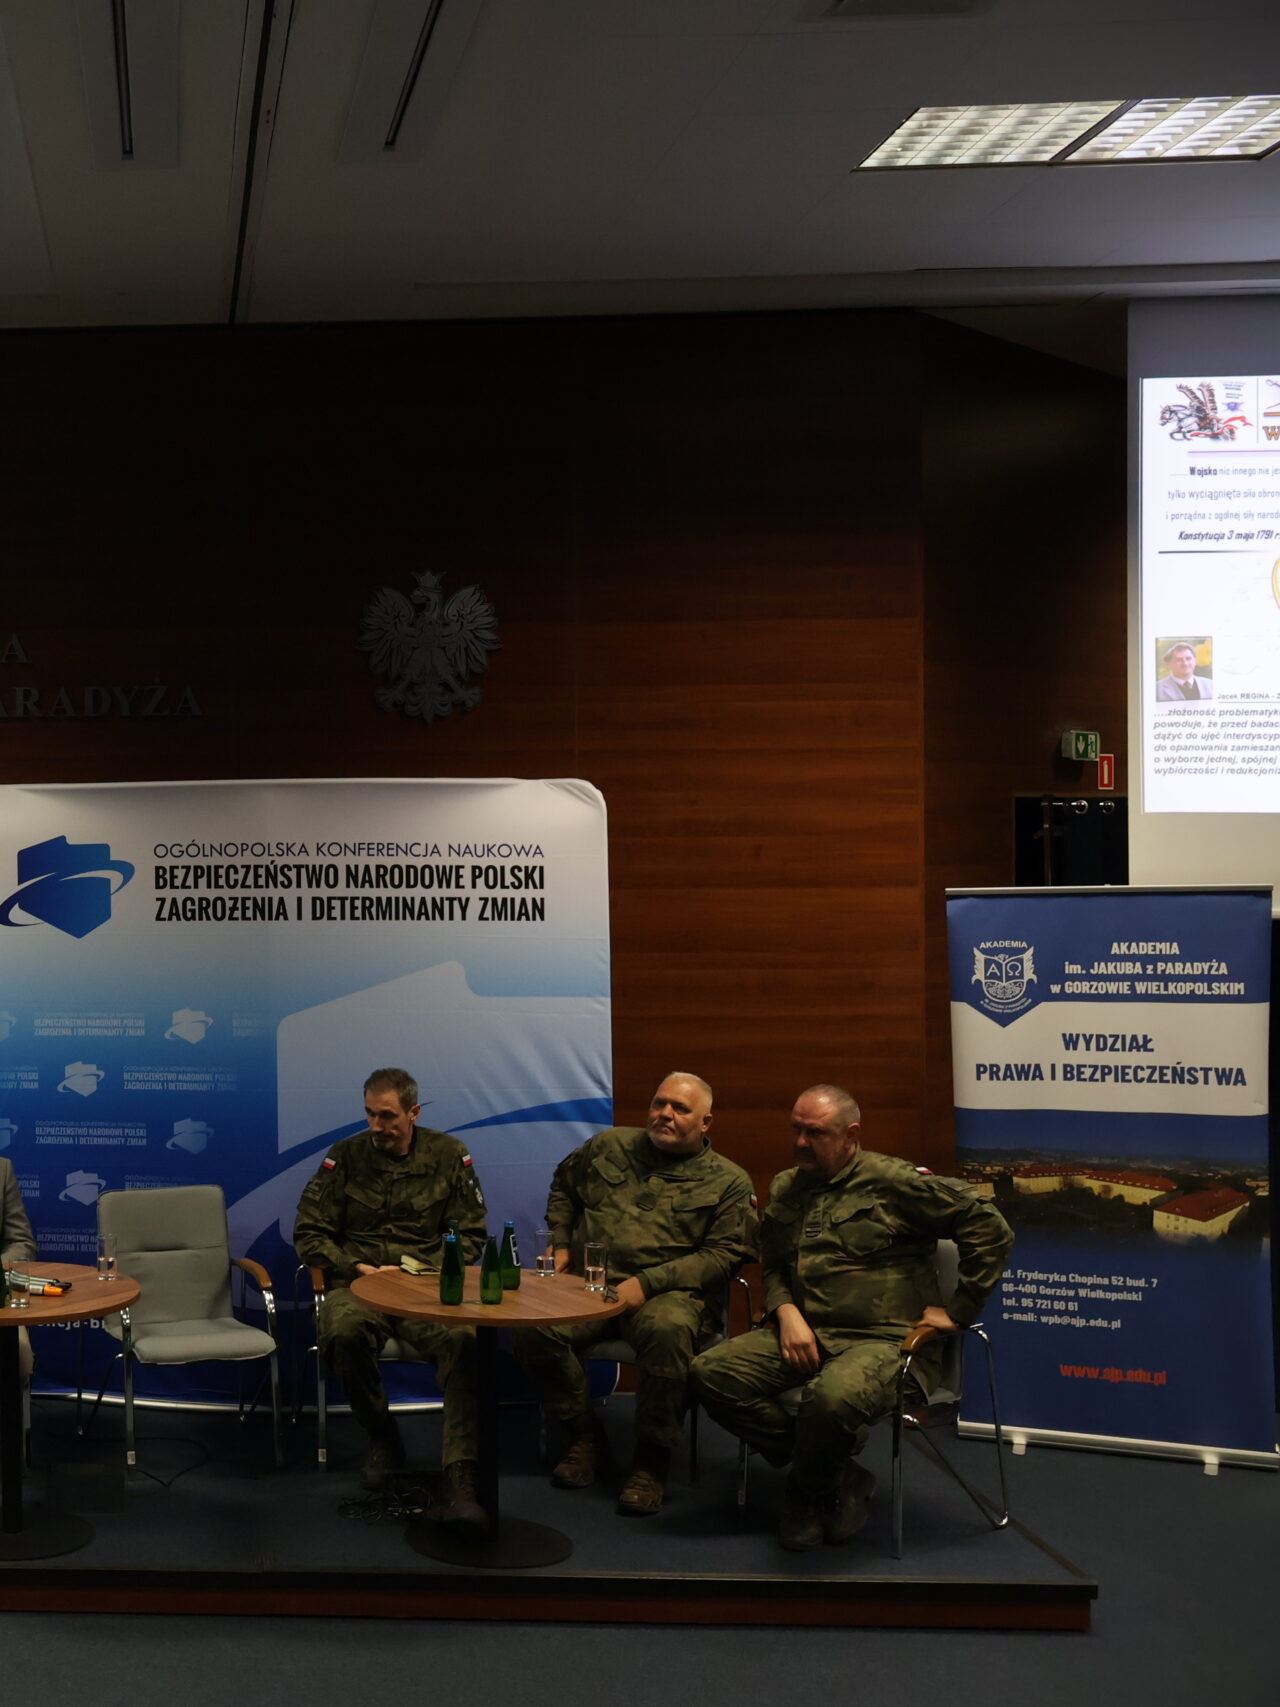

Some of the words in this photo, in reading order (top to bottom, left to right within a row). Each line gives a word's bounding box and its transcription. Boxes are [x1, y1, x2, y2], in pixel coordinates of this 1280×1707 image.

[1189, 466, 1218, 477] Wojsko
[1220, 719, 1248, 729] przed
[1185, 731, 1198, 740] do
[1153, 743, 1167, 752] do
[1169, 743, 1228, 753] opanowania
[1153, 756, 1161, 764] o
[1164, 754, 1204, 765] wyborze
[153, 839, 310, 859] OGÓLNOPOLSKA
[316, 841, 442, 859] KONFERENCJA
[448, 842, 545, 859] NAUKOWA
[154, 860, 339, 891] BEZPIECZEŃSTWO
[345, 863, 465, 891] NARODOWE
[471, 863, 545, 891] POLSKI
[154, 895, 289, 923] ZAGROŻENIA
[296, 895, 303, 922] I
[310, 896, 470, 923] DETERMINANTY
[477, 896, 546, 923] ZMIAN
[979, 940, 1028, 949] AKADEMIA
[1110, 941, 1180, 956] AKADEMIA
[1064, 961, 1086, 975] im.
[1090, 961, 1144, 975] JAKUBA
[1146, 964, 1154, 975] z
[1157, 958, 1229, 976] PARADYŻA
[1050, 983, 1062, 994] w
[1064, 981, 1132, 995] GORZOWIE
[1135, 981, 1246, 996] WIELKOPOLSKIM
[1062, 1032, 1154, 1053] WYDZIAŁ
[976, 1063, 1044, 1082] PRAWA
[1050, 1063, 1056, 1082] I
[1063, 1061, 1247, 1086] BEZPIECZEŃSTWA
[1016, 1269, 1067, 1283] Fryderyka
[1068, 1273, 1110, 1286] Chopina
[1110, 1275, 1125, 1287] 52
[1126, 1277, 1149, 1288] bud.
[1151, 1278, 1158, 1288] 7
[1001, 1282, 1038, 1295] 66-400
[1039, 1285, 1076, 1297] Gorzów
[1078, 1288, 1143, 1302] Wielkopolski
[1002, 1296, 1019, 1307] tel.
[1020, 1297, 1034, 1308] 95
[1035, 1298, 1052, 1309] 721
[1053, 1300, 1066, 1311] 60
[1067, 1301, 1079, 1312] 61
[1002, 1311, 1038, 1323] e-mail:
[1040, 1313, 1122, 1330] wpb@ajp.edu.pl
[1059, 1363, 1168, 1386] www.ajp.edu.pl
